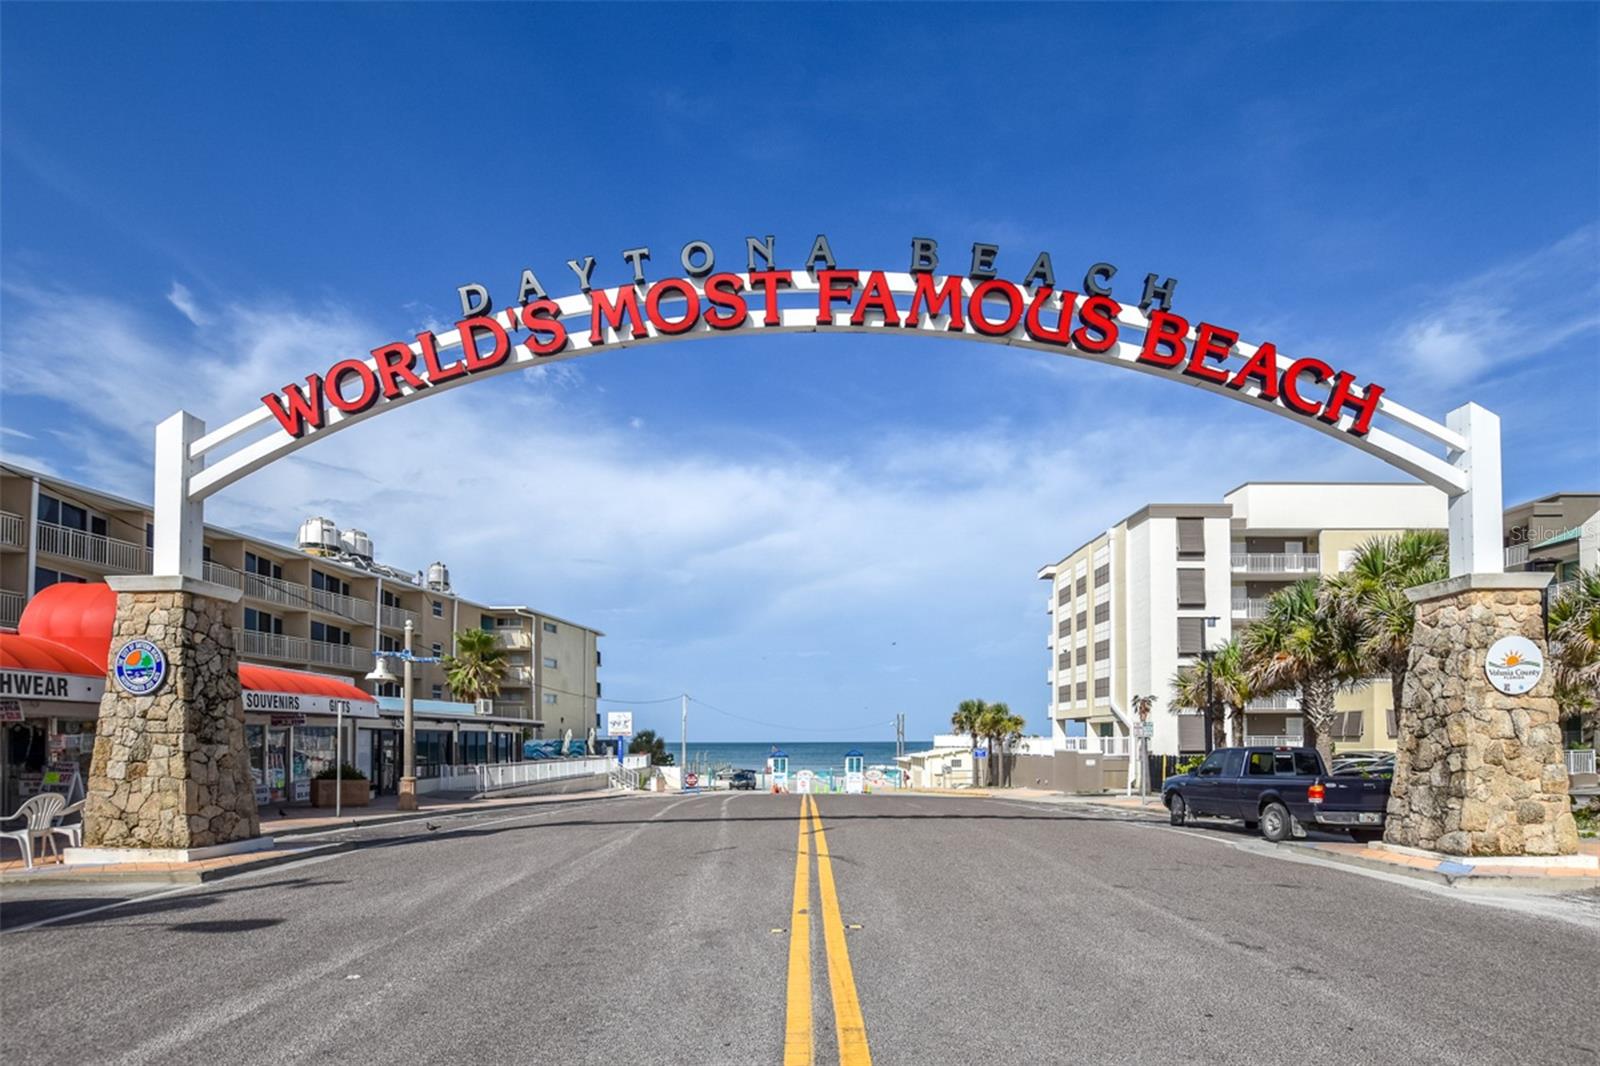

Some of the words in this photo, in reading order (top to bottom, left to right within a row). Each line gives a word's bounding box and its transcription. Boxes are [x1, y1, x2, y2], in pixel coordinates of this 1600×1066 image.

[457, 234, 836, 317] DAYTONA
[910, 237, 1178, 312] BEACH
[262, 300, 567, 438] WORLD'S
[589, 270, 792, 345] MOST
[816, 269, 1122, 353] FAMOUS
[1137, 308, 1385, 437] BEACH
[0, 673, 69, 697] HWEAR
[1515, 669, 1540, 677] County
[246, 693, 300, 710] SOUVENIRS
[329, 699, 351, 713] GITS
